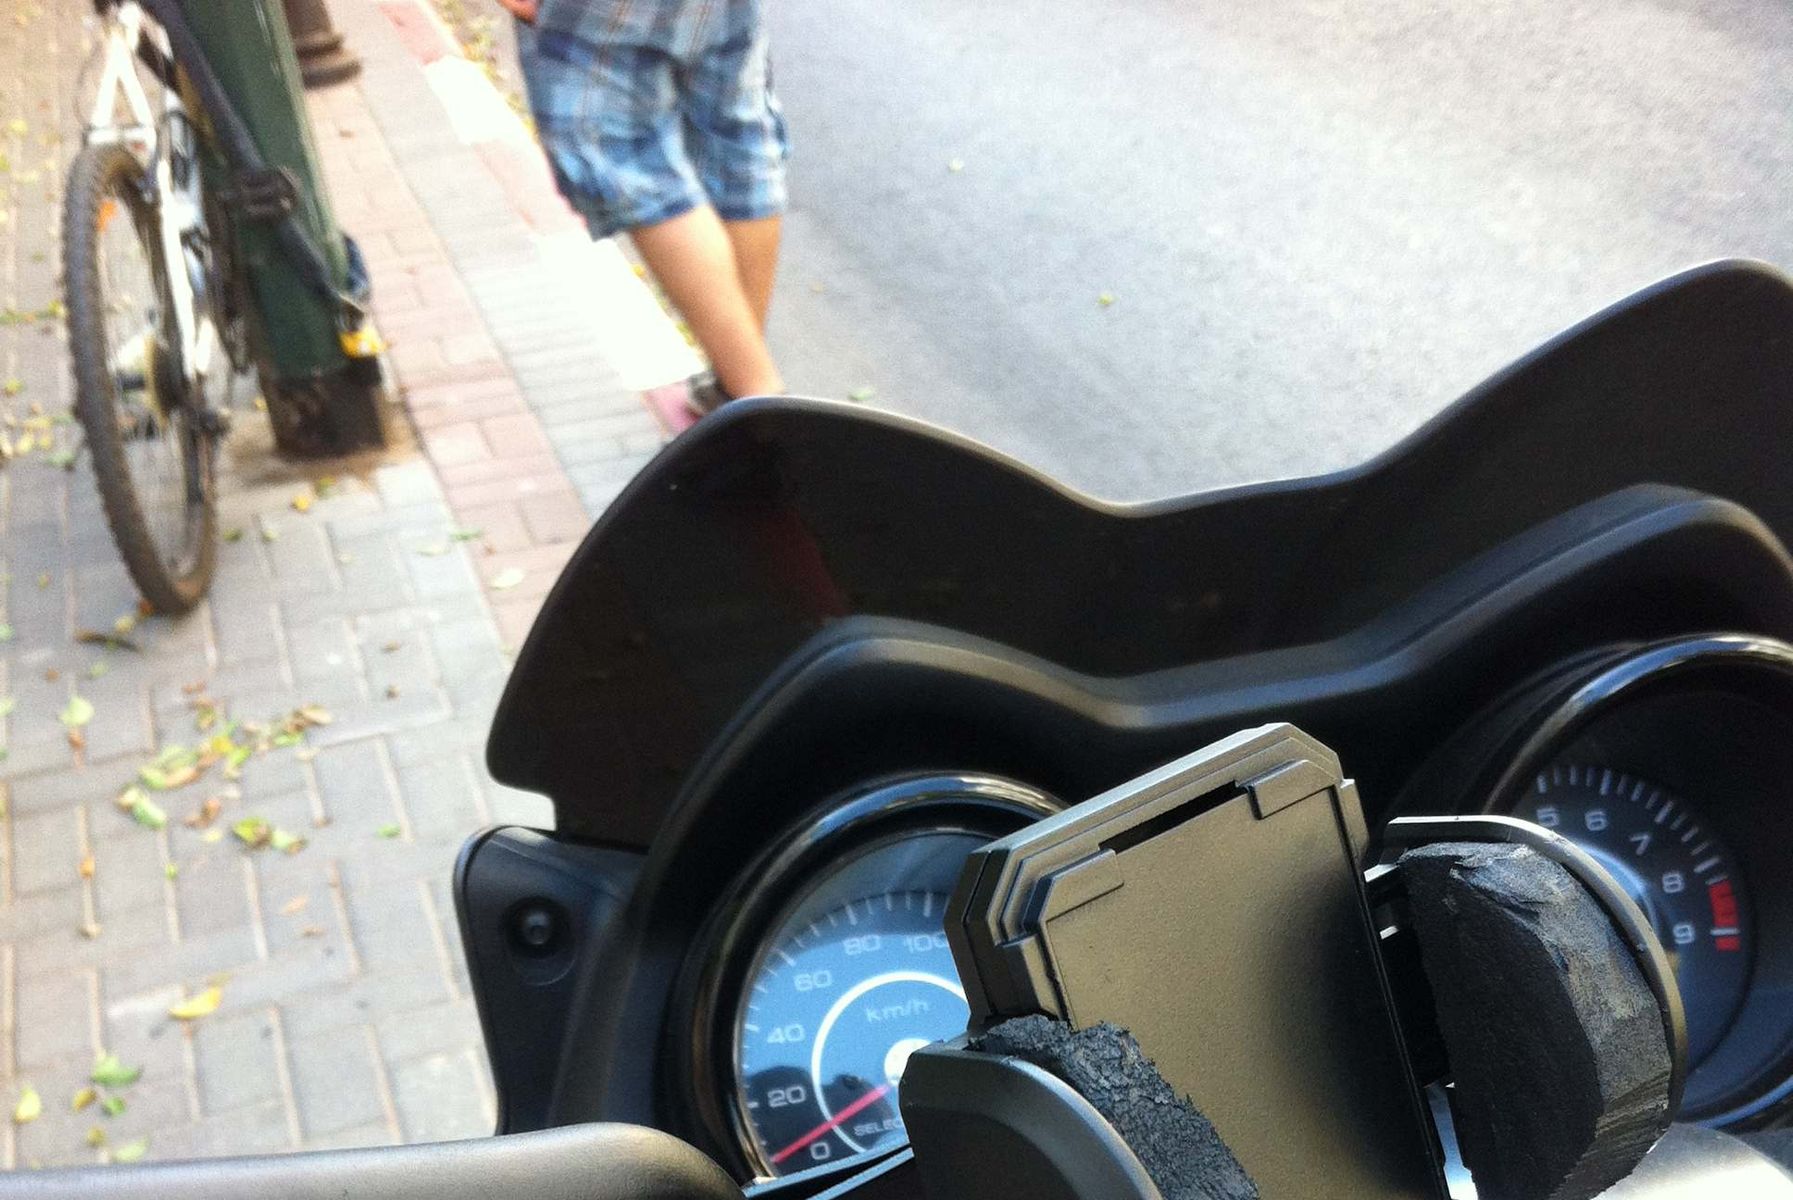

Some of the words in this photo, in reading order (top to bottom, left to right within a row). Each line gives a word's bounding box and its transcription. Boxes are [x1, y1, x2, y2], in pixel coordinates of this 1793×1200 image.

[1536, 807, 1560, 828] 5
[1584, 810, 1608, 832] 6
[1629, 833, 1651, 856] 7
[1662, 871, 1685, 894] 8
[843, 934, 881, 955] 80
[904, 932, 948, 953] 100
[1672, 923, 1696, 945] 9
[794, 970, 832, 992] 60
[866, 999, 929, 1022] km/h
[767, 1024, 805, 1044] 40
[768, 1086, 805, 1108] 20
[810, 1142, 830, 1160] 0
